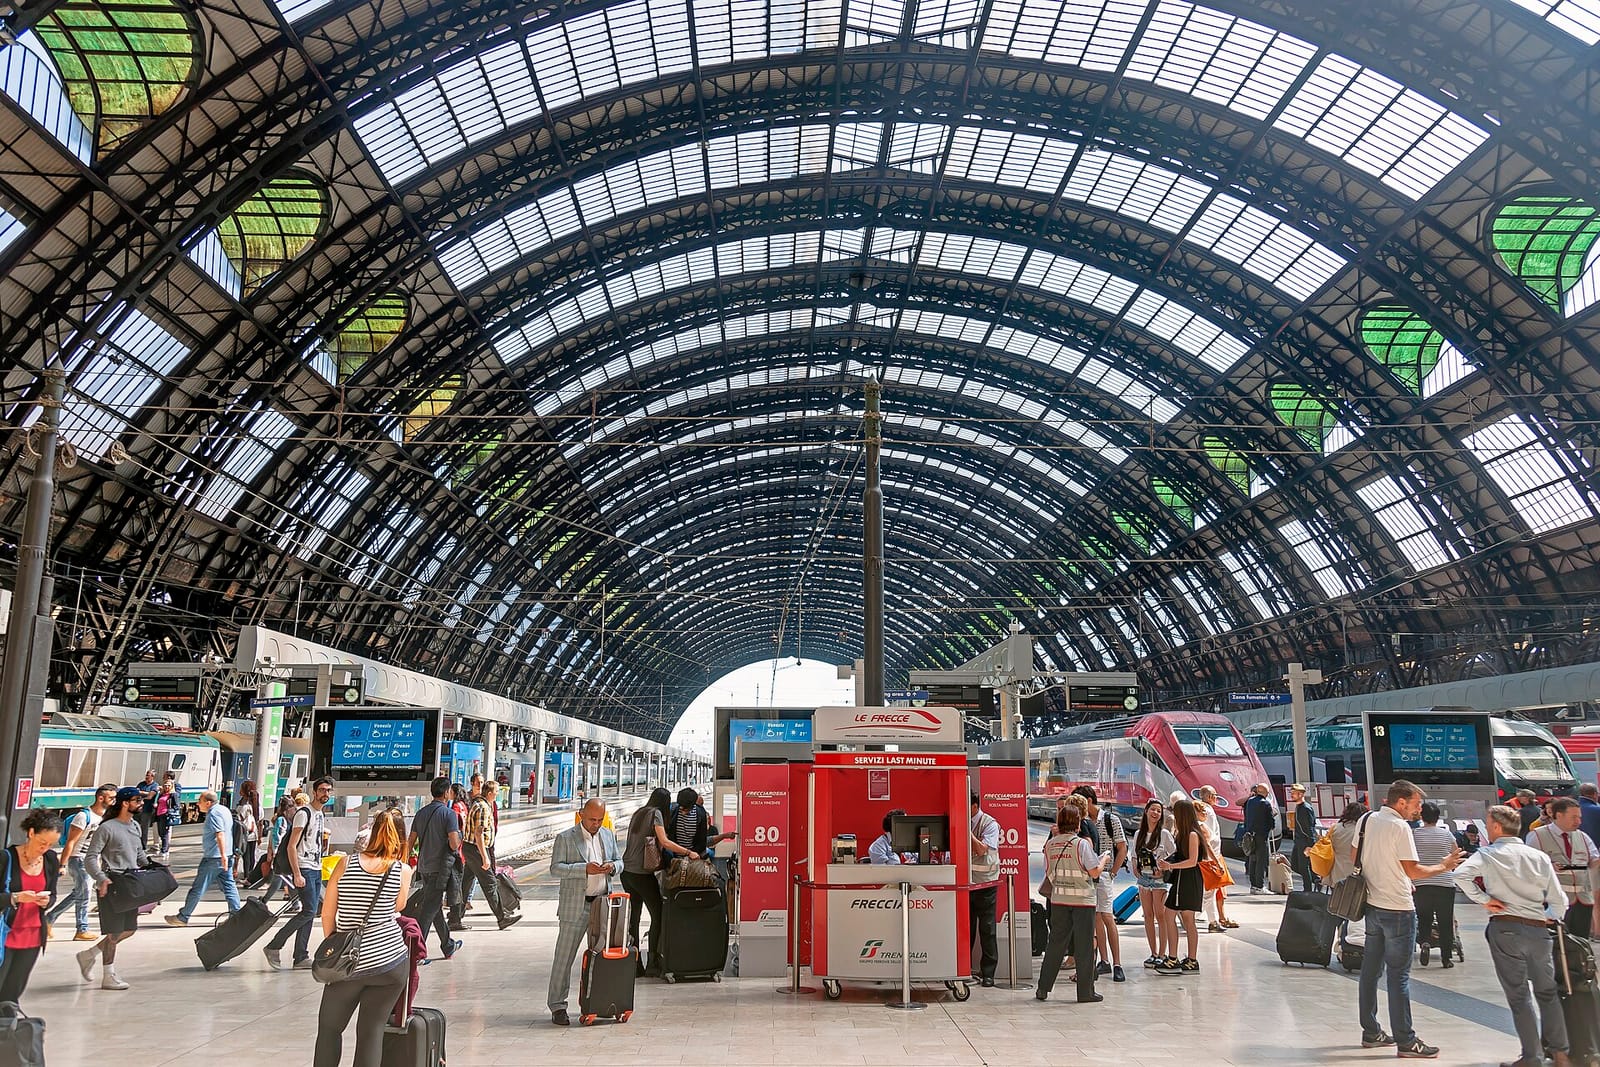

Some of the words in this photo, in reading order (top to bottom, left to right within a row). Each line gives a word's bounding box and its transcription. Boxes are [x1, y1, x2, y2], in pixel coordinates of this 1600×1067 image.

[854, 714, 868, 722] LE
[870, 714, 910, 722] FRECCE
[318, 721, 329, 732] 11
[745, 728, 756, 736] 20
[1372, 725, 1385, 737] 13
[754, 826, 780, 843] 80
